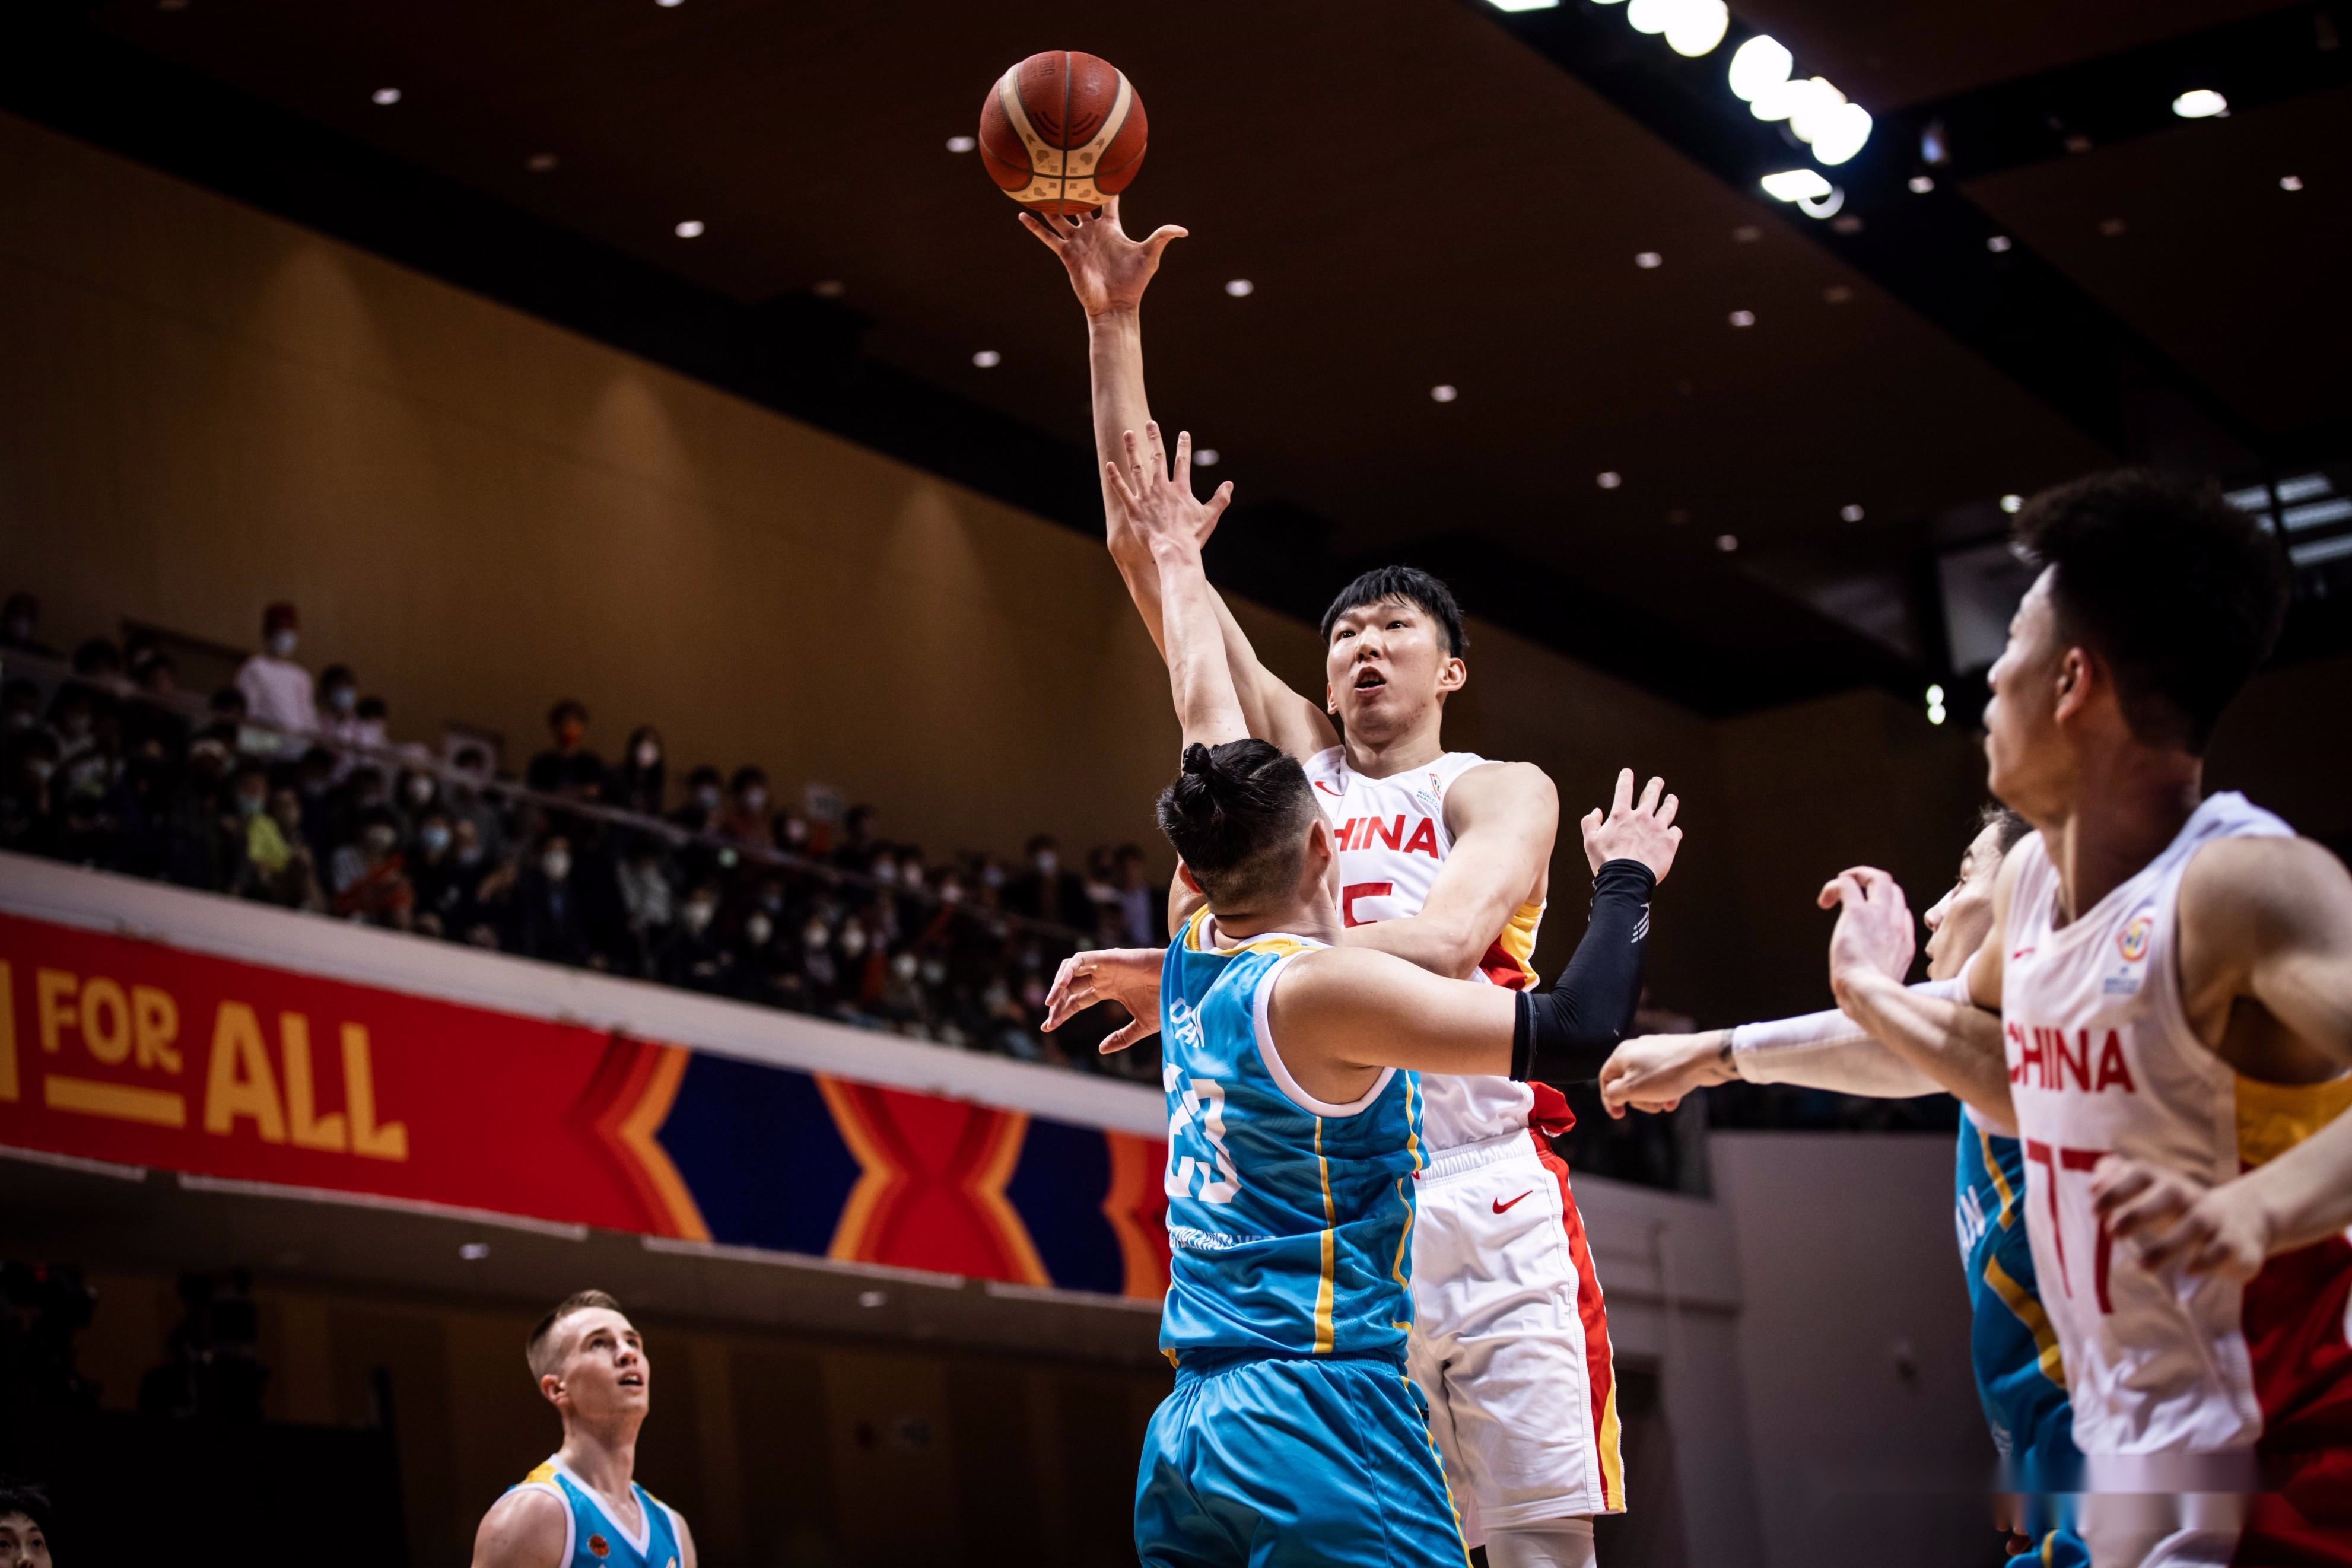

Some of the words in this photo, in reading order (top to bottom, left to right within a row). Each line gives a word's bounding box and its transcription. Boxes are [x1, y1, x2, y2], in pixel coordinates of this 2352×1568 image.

[1334, 814, 1439, 860] HINA
[36, 966, 183, 1074] FOR
[204, 999, 409, 1163] ALL
[2026, 1138, 2113, 1315] 77
